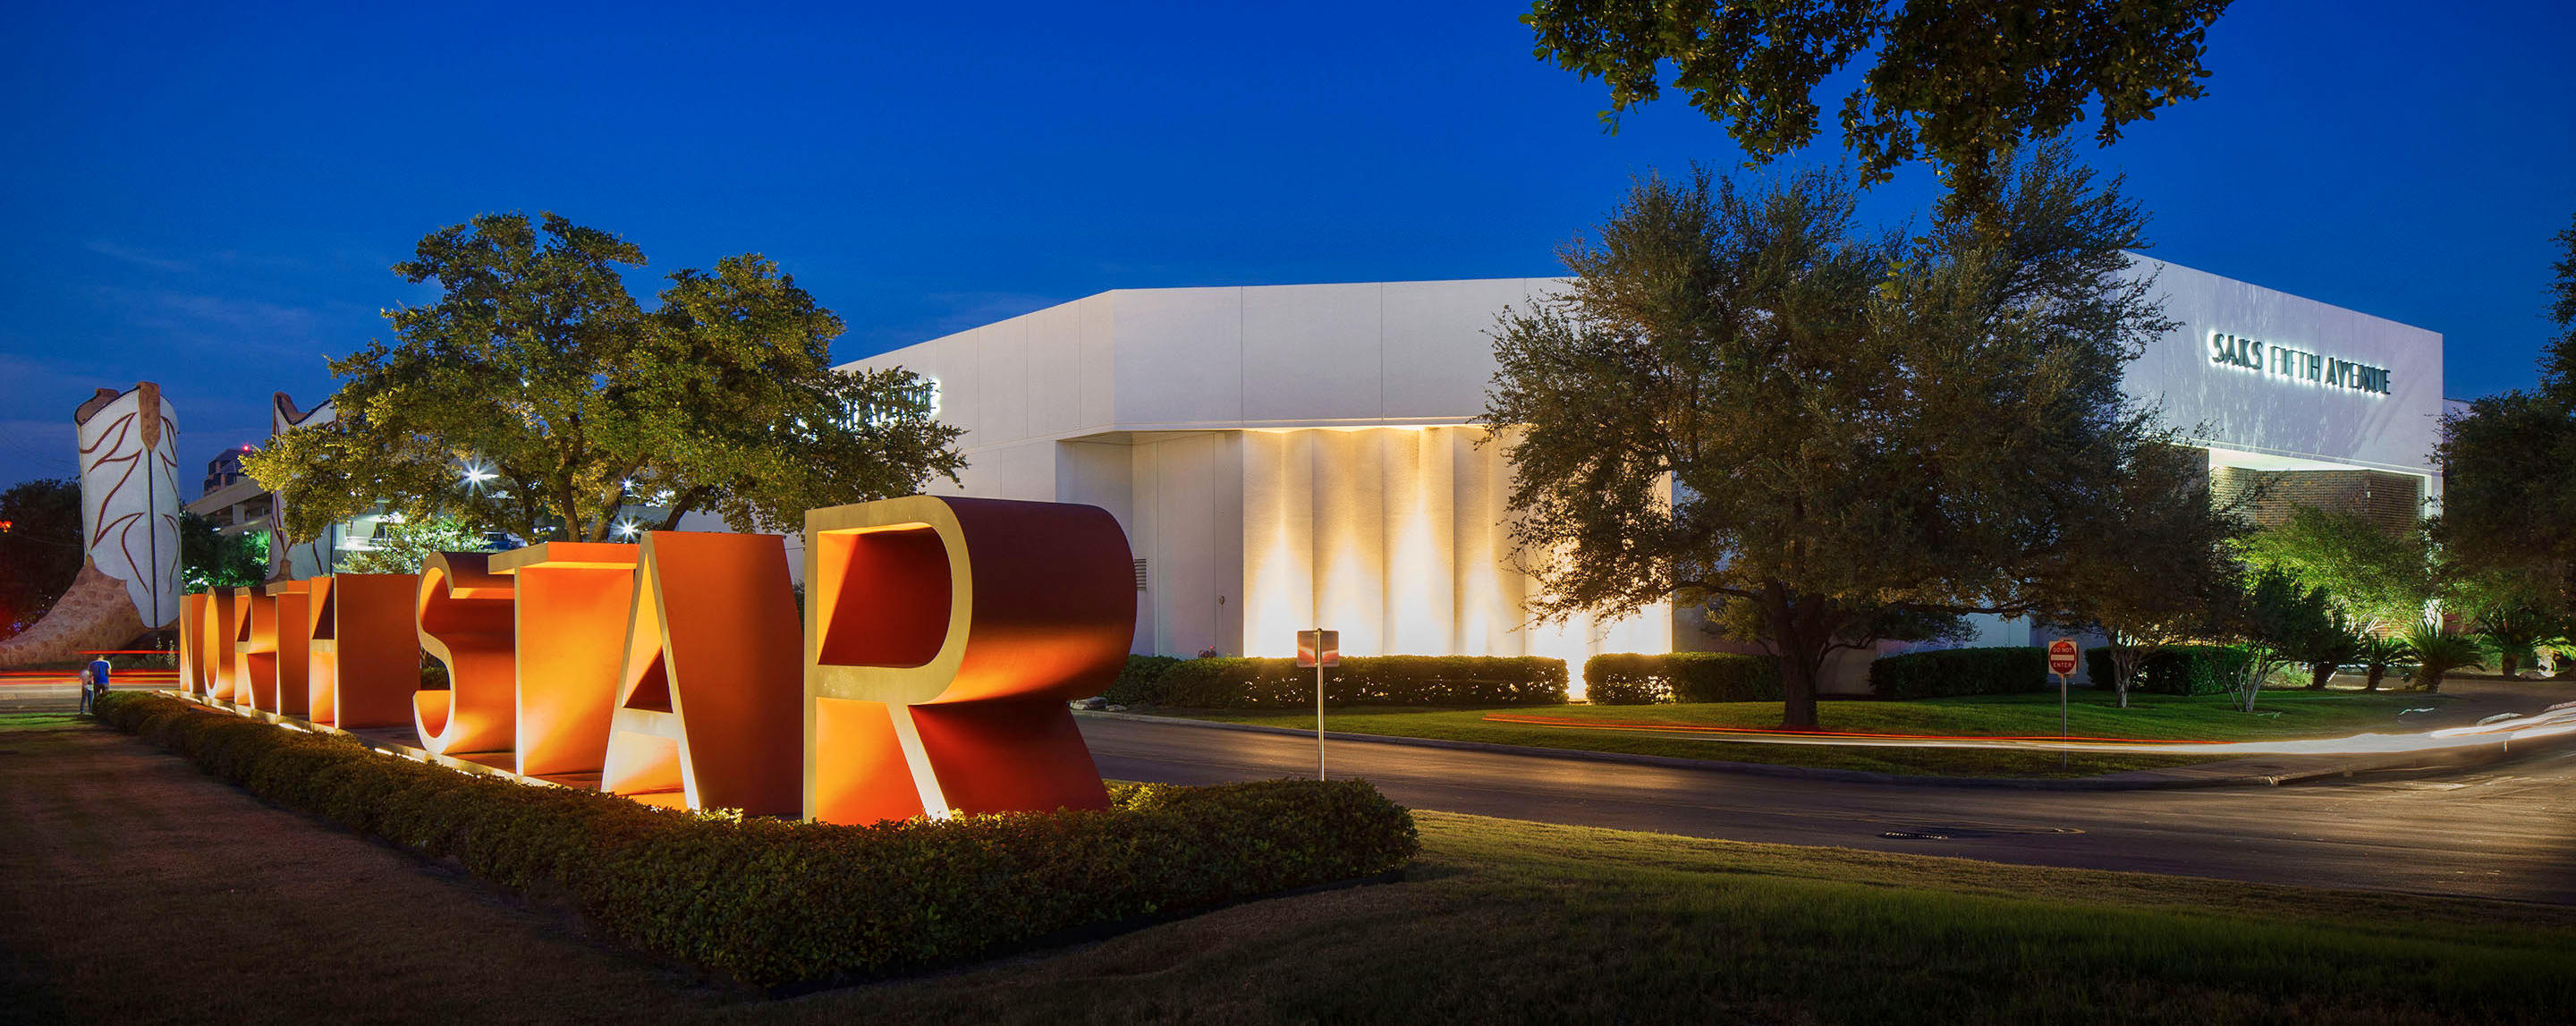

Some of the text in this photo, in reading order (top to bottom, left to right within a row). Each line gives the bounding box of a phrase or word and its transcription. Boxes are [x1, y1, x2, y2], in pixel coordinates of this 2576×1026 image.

[2212, 333, 2391, 395] SAKS FIFTH AVENUE
[179, 495, 1138, 825] NORTH STAR
